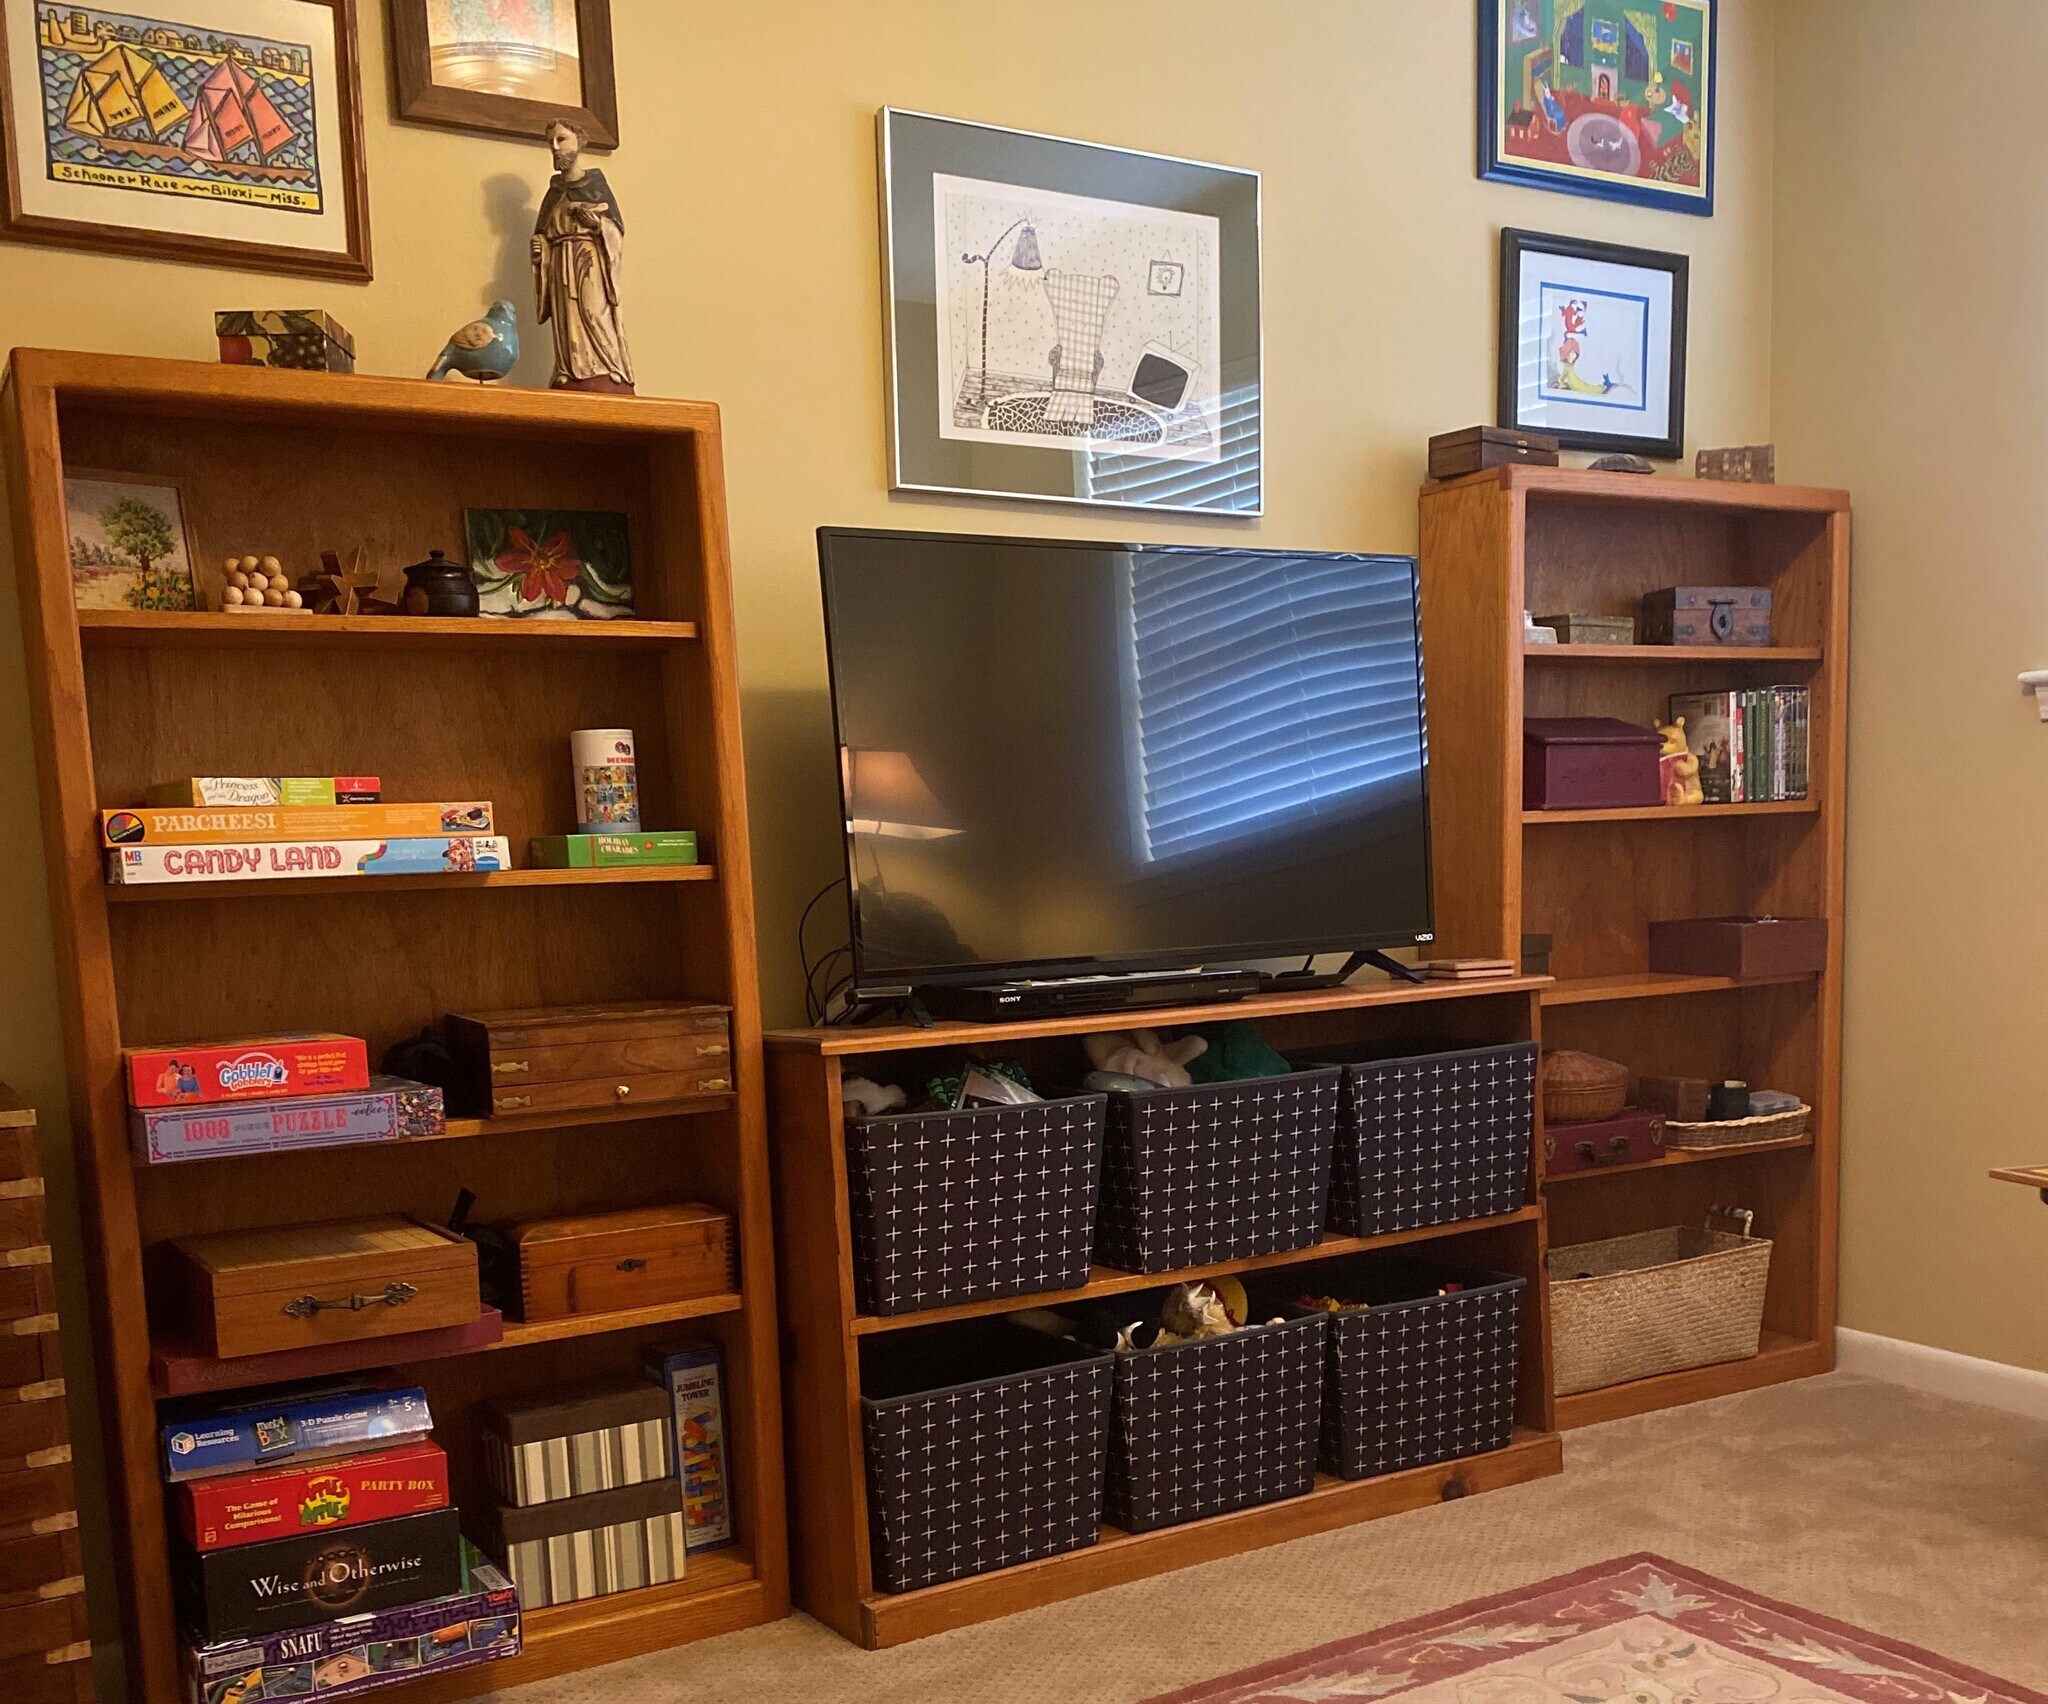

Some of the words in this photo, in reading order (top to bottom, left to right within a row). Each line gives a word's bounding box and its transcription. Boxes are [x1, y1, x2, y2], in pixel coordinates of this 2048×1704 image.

[62, 165, 137, 185] Schooner
[140, 174, 178, 190] Race
[211, 184, 252, 200] Biloxi
[271, 192, 306, 206] Miss.
[213, 778, 258, 792] Princess
[227, 790, 269, 805] Dragon
[153, 813, 277, 832] PARCHEESI
[124, 850, 142, 862] MB
[164, 848, 261, 876] CANDY
[270, 846, 341, 873] LAND
[999, 995, 1021, 1004] SONY
[221, 1061, 273, 1085] Gobblet
[183, 1118, 231, 1142] 1008
[271, 1107, 348, 1133] PUZZLE
[681, 1388, 710, 1402] TOWER
[300, 1418, 316, 1428] 3-D
[316, 1413, 342, 1425] Puzzle
[344, 1410, 368, 1420] Game
[195, 1428, 235, 1440] Learning
[196, 1434, 240, 1448] Resources
[361, 1480, 404, 1491] PARTY
[407, 1479, 435, 1491] BOX
[225, 1504, 242, 1513] The
[243, 1500, 267, 1510] Game
[269, 1498, 279, 1506] of
[233, 1508, 272, 1520] Hilarious
[224, 1514, 282, 1531] Comparisons!
[250, 1574, 300, 1598] Wise
[302, 1571, 327, 1590] and
[329, 1555, 422, 1583] Otherwise
[488, 1589, 514, 1603] TOMY
[280, 1631, 324, 1659] SNAFU
